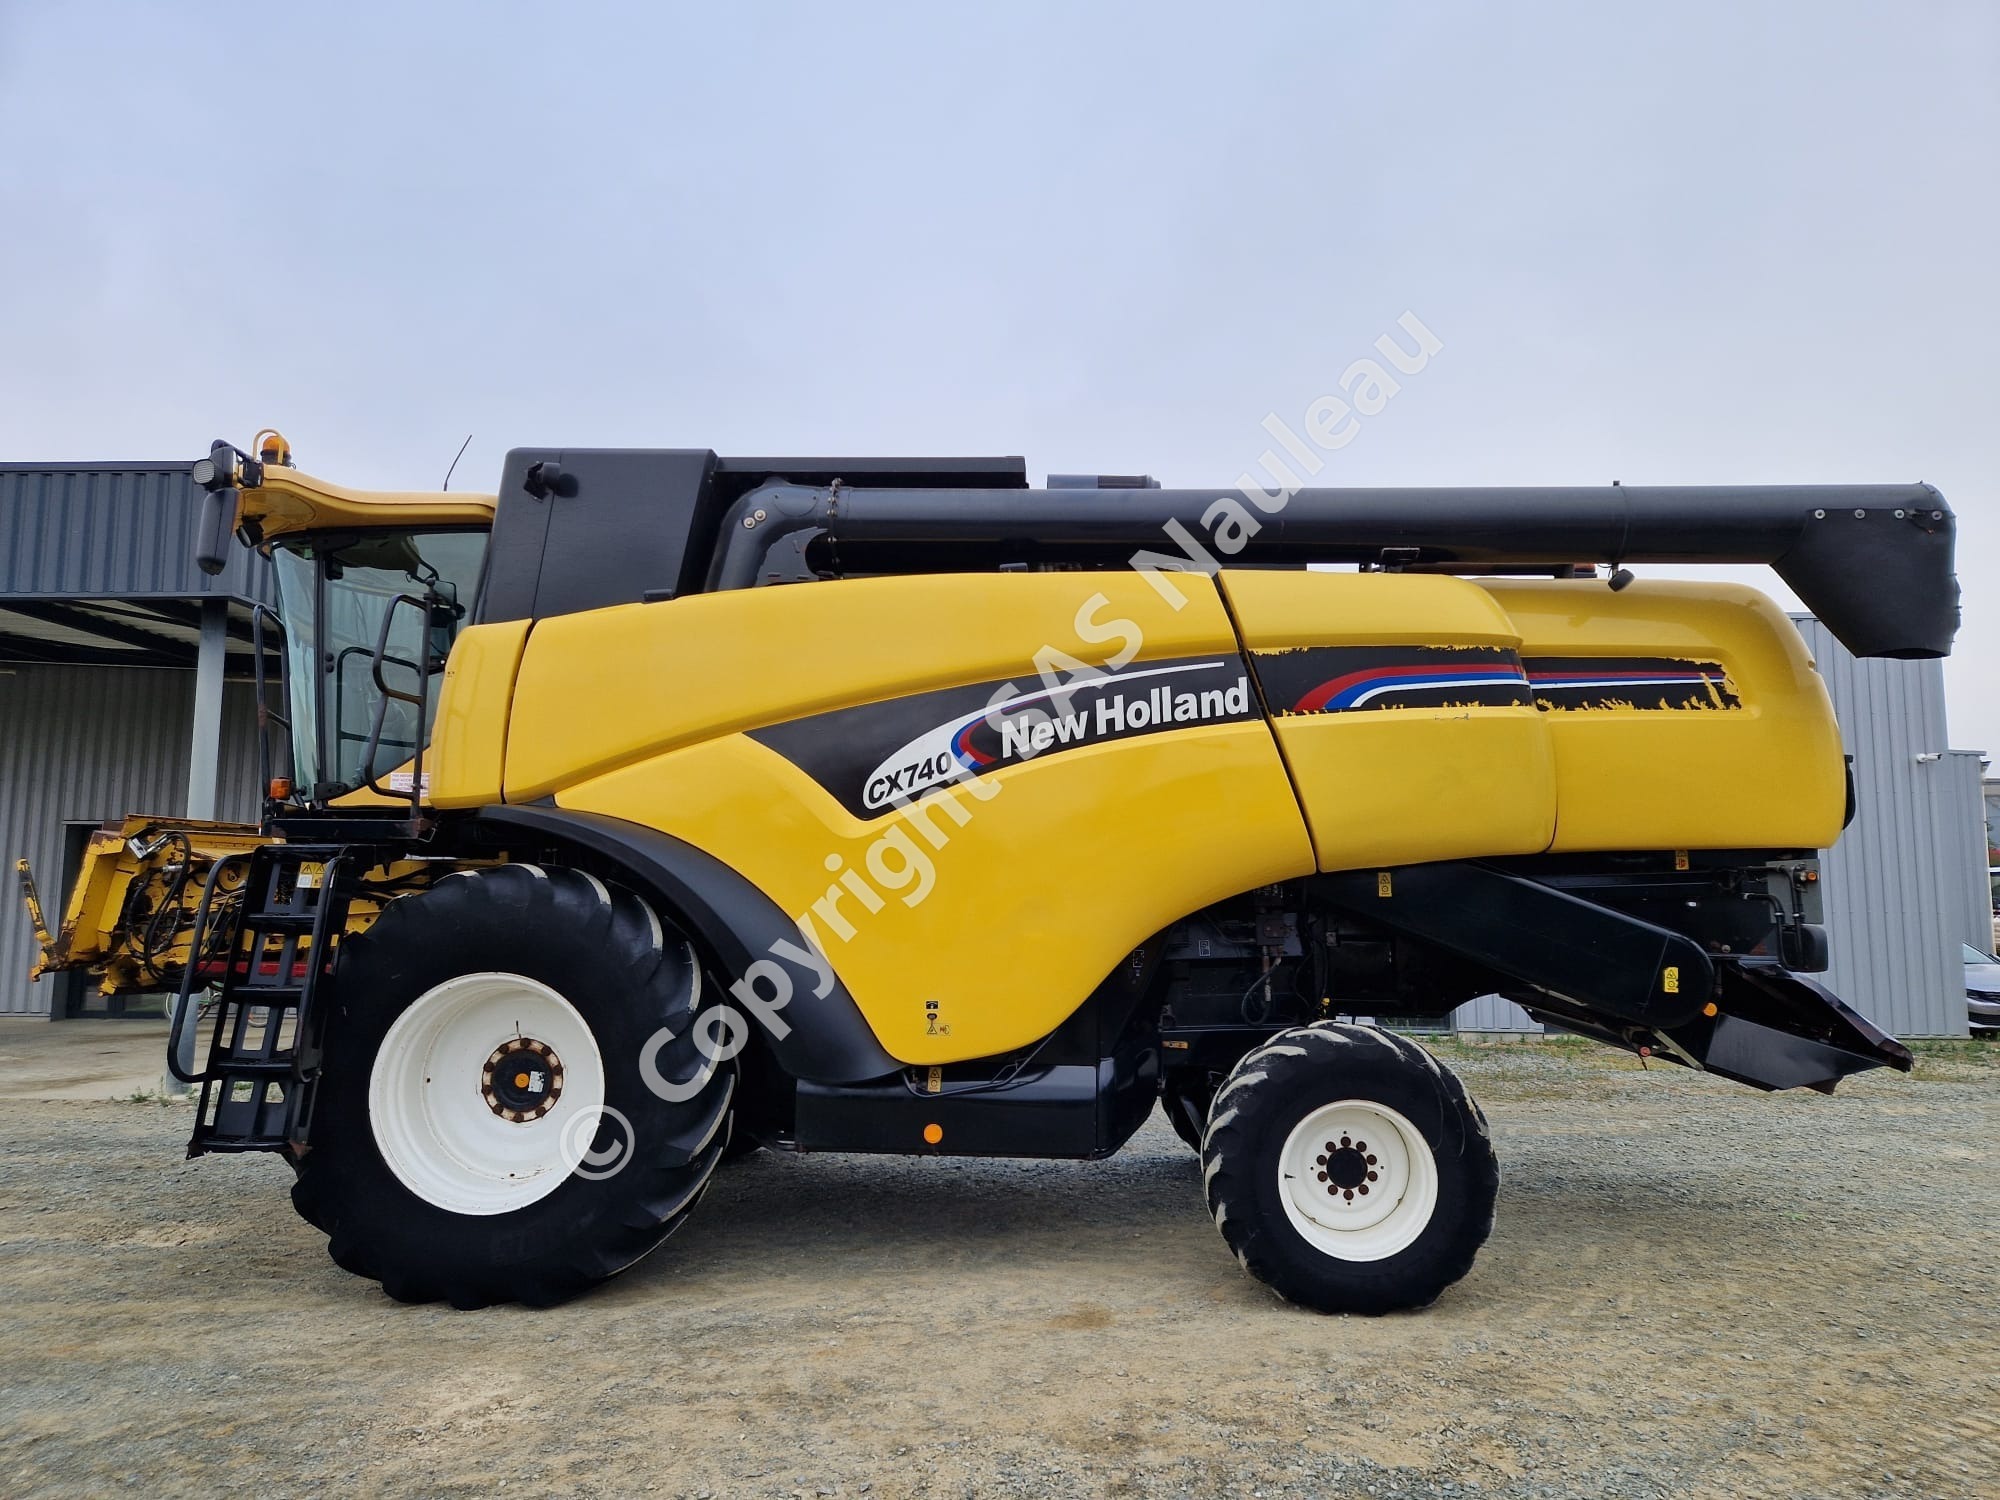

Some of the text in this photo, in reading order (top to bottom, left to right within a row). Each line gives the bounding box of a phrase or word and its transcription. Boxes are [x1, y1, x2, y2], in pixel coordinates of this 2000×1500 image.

[1001, 676, 1249, 759] New Holland
[868, 751, 952, 804] CX740
